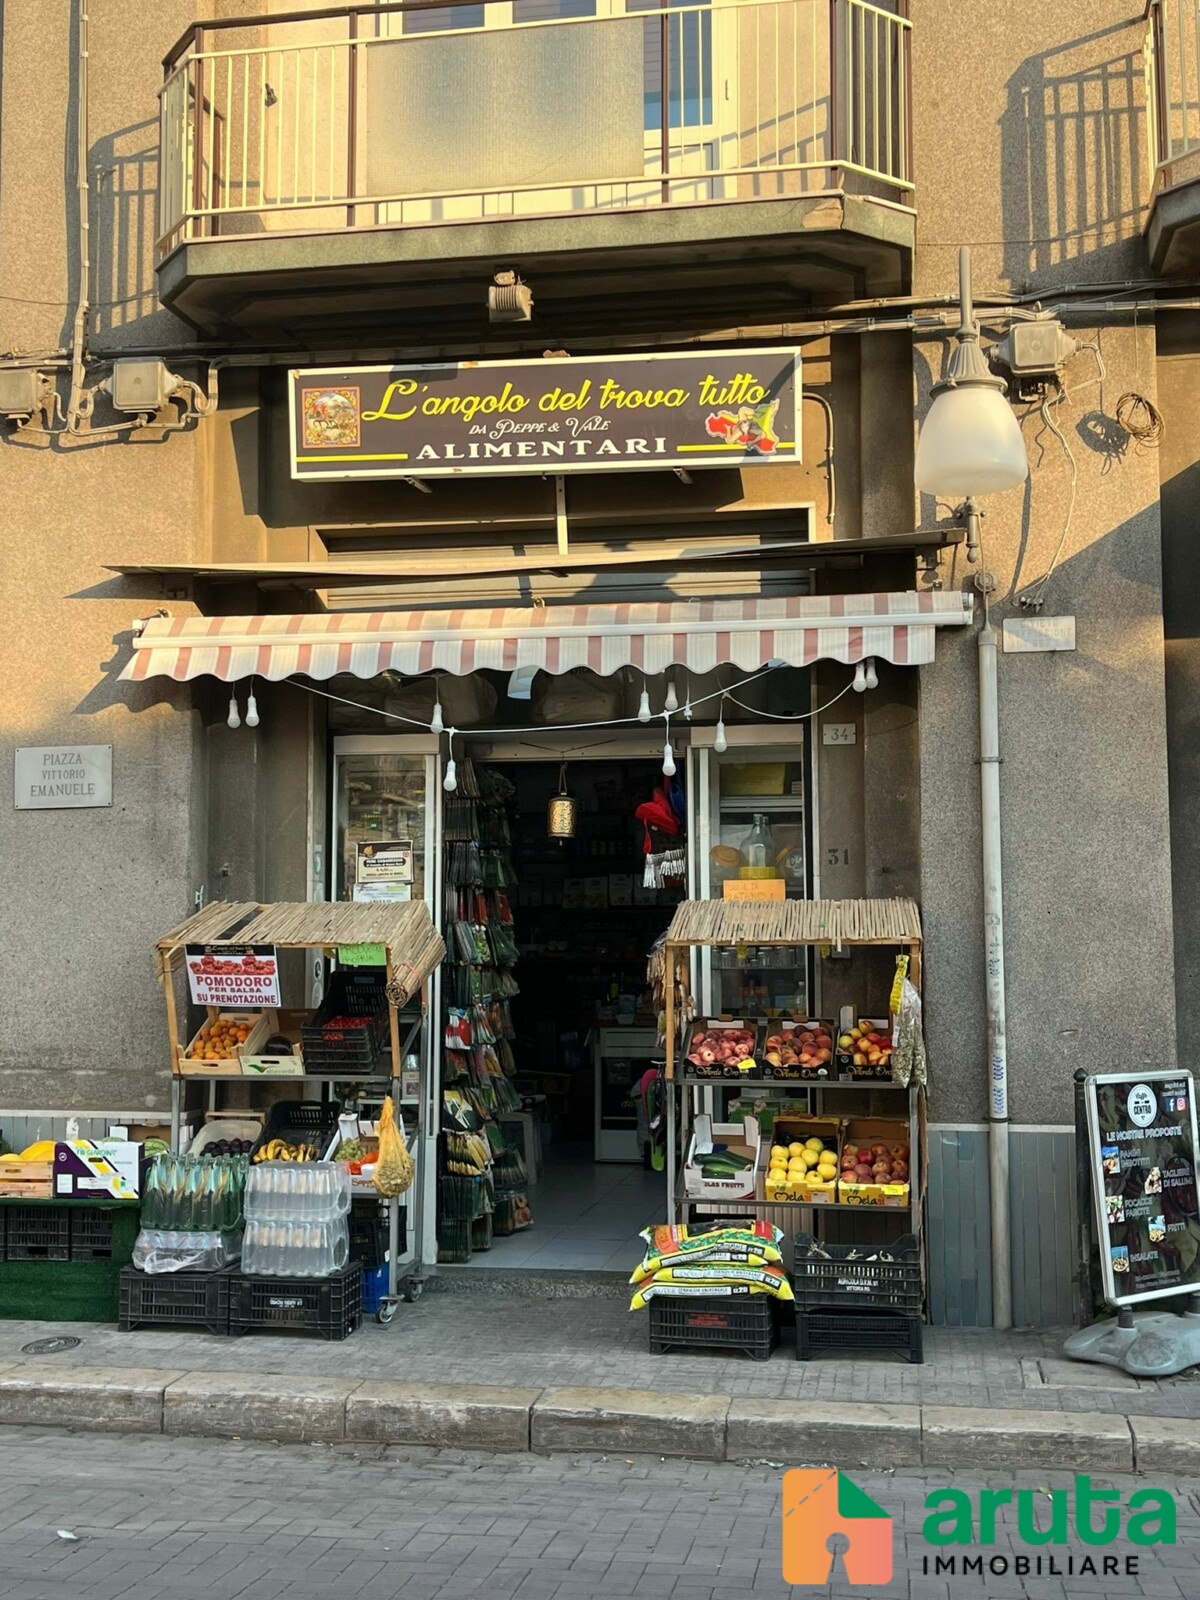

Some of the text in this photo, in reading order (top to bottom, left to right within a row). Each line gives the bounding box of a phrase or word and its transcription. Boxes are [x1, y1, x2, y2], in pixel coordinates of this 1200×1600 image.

[361, 373, 770, 422] L'angolo del trova tutto
[547, 424, 561, 433] &
[416, 437, 667, 460] ALIMENTARI
[830, 728, 849, 741] 34
[42, 753, 83, 766] PIAZZA
[41, 769, 86, 780] VITTORIO
[30, 783, 96, 797] EMANUELE
[827, 848, 850, 866] 31
[196, 976, 273, 987] POMODORO
[196, 993, 277, 1004] SU PRENOTAZIONE
[723, 1067, 739, 1076] Oro
[773, 1067, 817, 1078] Verde Oro
[846, 1065, 873, 1076] Verde
[1133, 1105, 1152, 1115] CENTRO
[1106, 1131, 1116, 1142] LE
[1145, 1126, 1182, 1138] PROPOSTE
[1163, 1179, 1171, 1188] DI
[774, 1192, 805, 1202] Mela
[847, 1195, 878, 1205] Mela
[1130, 1250, 1159, 1263] INSALATE
